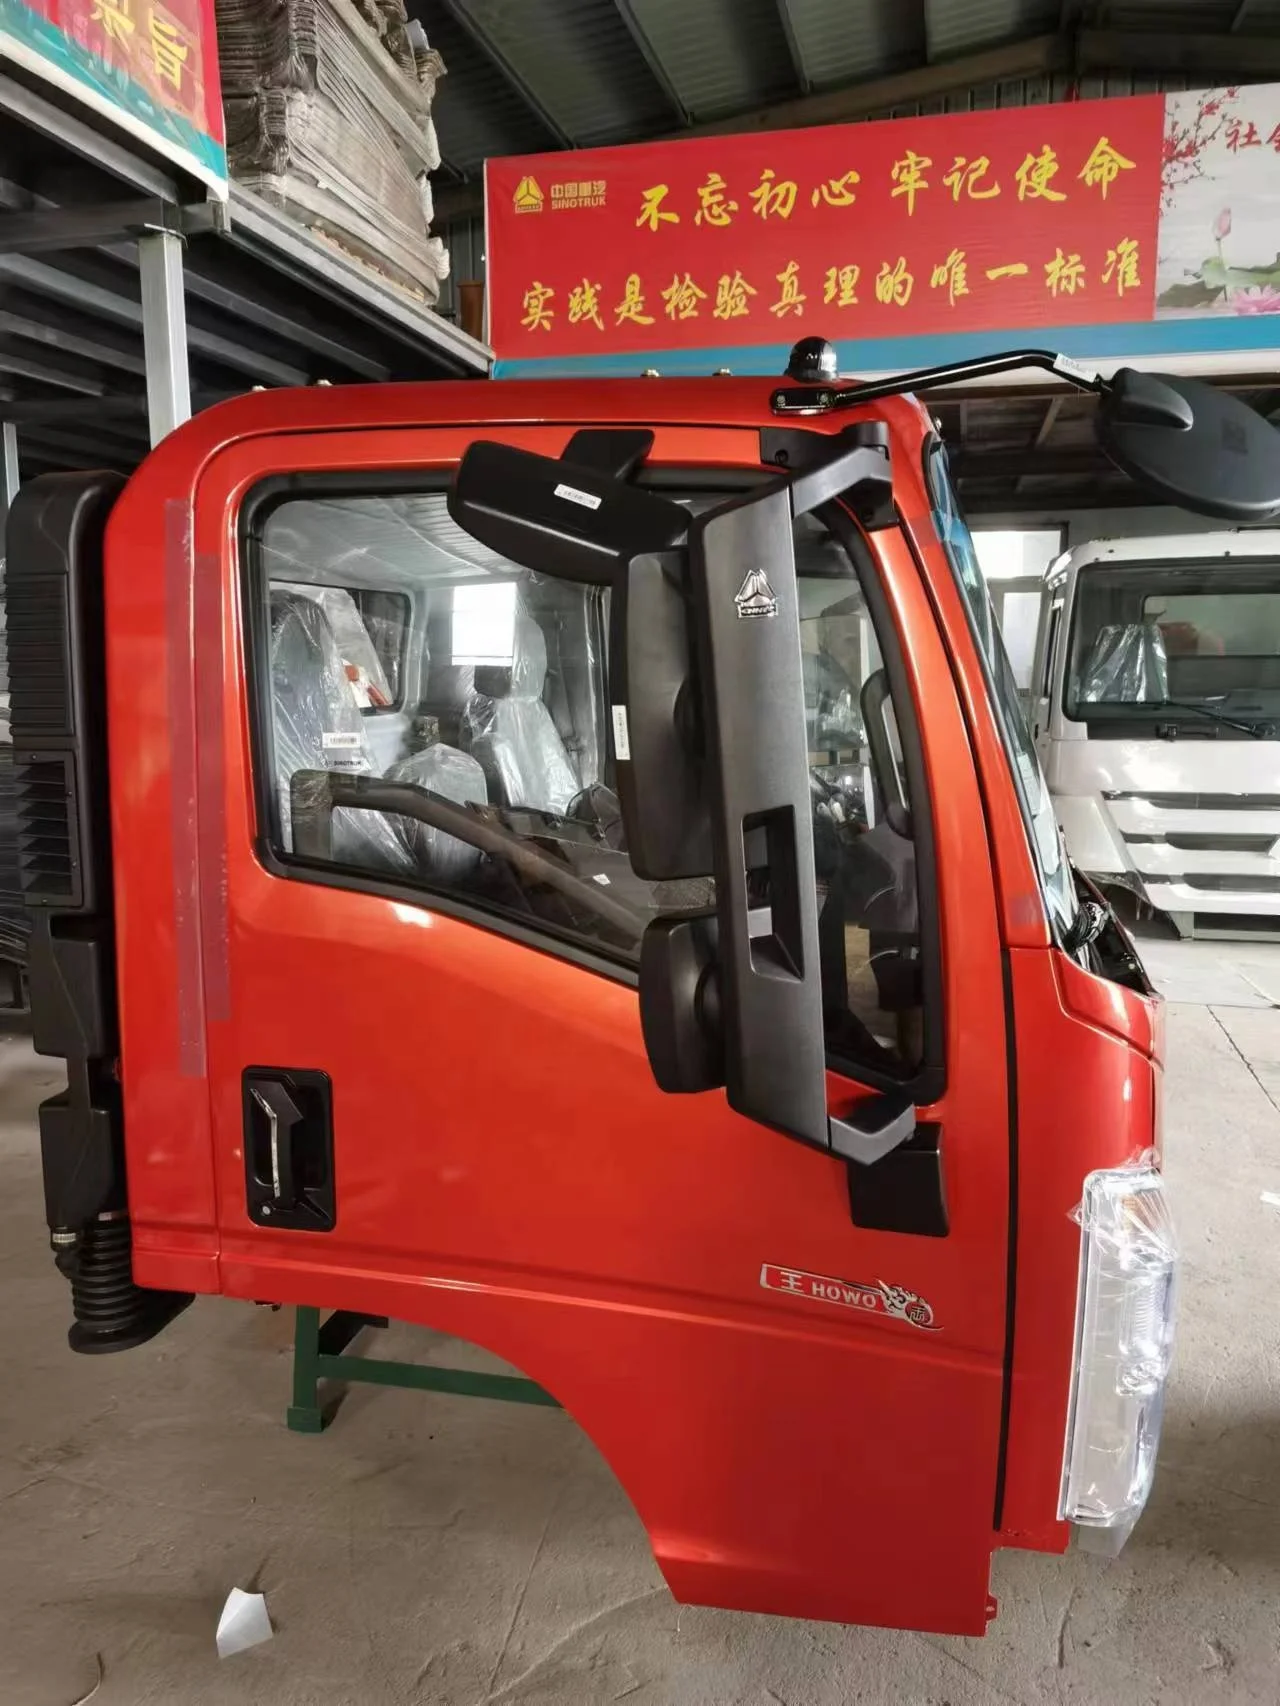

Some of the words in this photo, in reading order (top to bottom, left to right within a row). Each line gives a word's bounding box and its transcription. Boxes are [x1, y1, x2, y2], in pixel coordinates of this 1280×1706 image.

[551, 196, 606, 210] SINOTRUK
[636, 170, 860, 232] 不忘初心
[891, 136, 1137, 217] 牢记使命
[521, 236, 1142, 331] 实践是检验真理的唯一标准
[811, 1281, 877, 1308] HOWO
